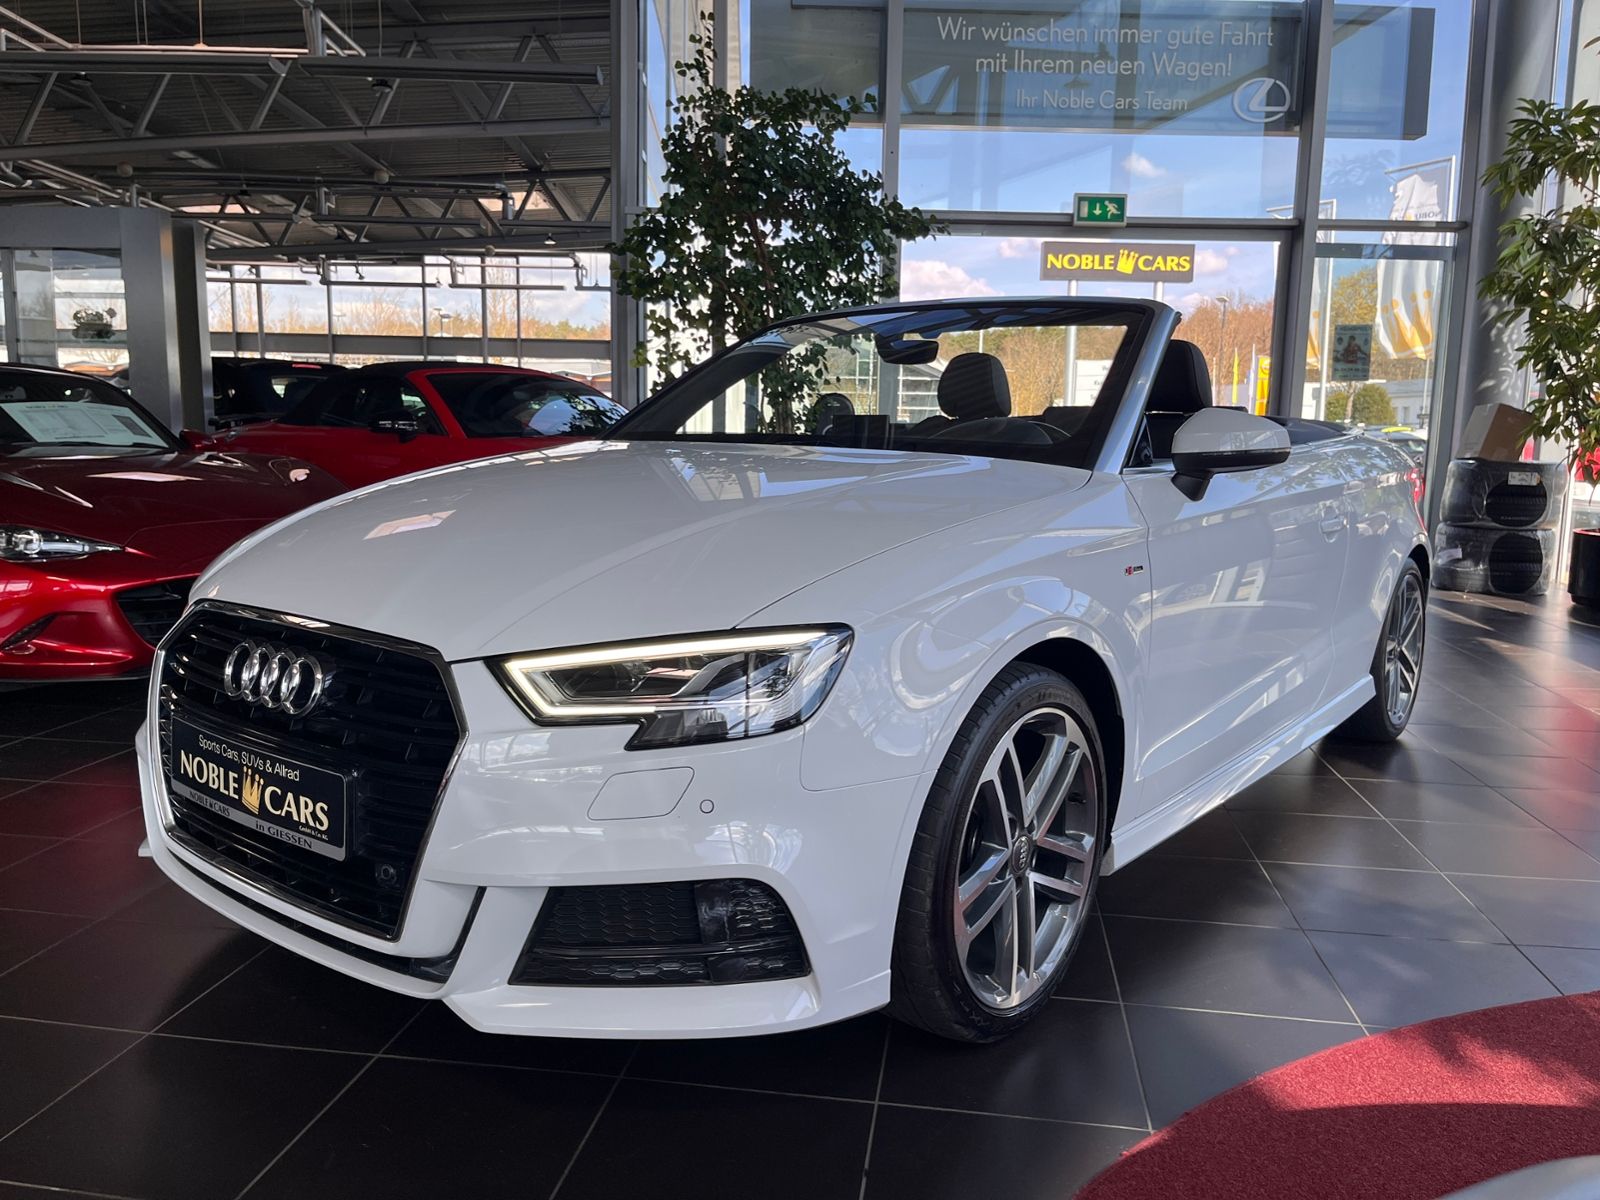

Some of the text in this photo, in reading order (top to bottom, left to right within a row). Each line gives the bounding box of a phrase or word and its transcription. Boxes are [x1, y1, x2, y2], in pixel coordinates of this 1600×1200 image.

[937, 16, 1274, 52] Wir wünschen immer gute Fahrt
[975, 51, 1232, 82] mit Ihrem neuen Wagen!
[1016, 89, 1188, 111] Ihr Noble Cars Team
[1046, 253, 1191, 272] NOBLE CARS
[198, 734, 300, 782] Sports Cars, SUVs & Allrad
[180, 749, 329, 832] NOBLE CARS
[189, 790, 210, 808] NOBLE
[255, 820, 313, 849] in GIESSEN
